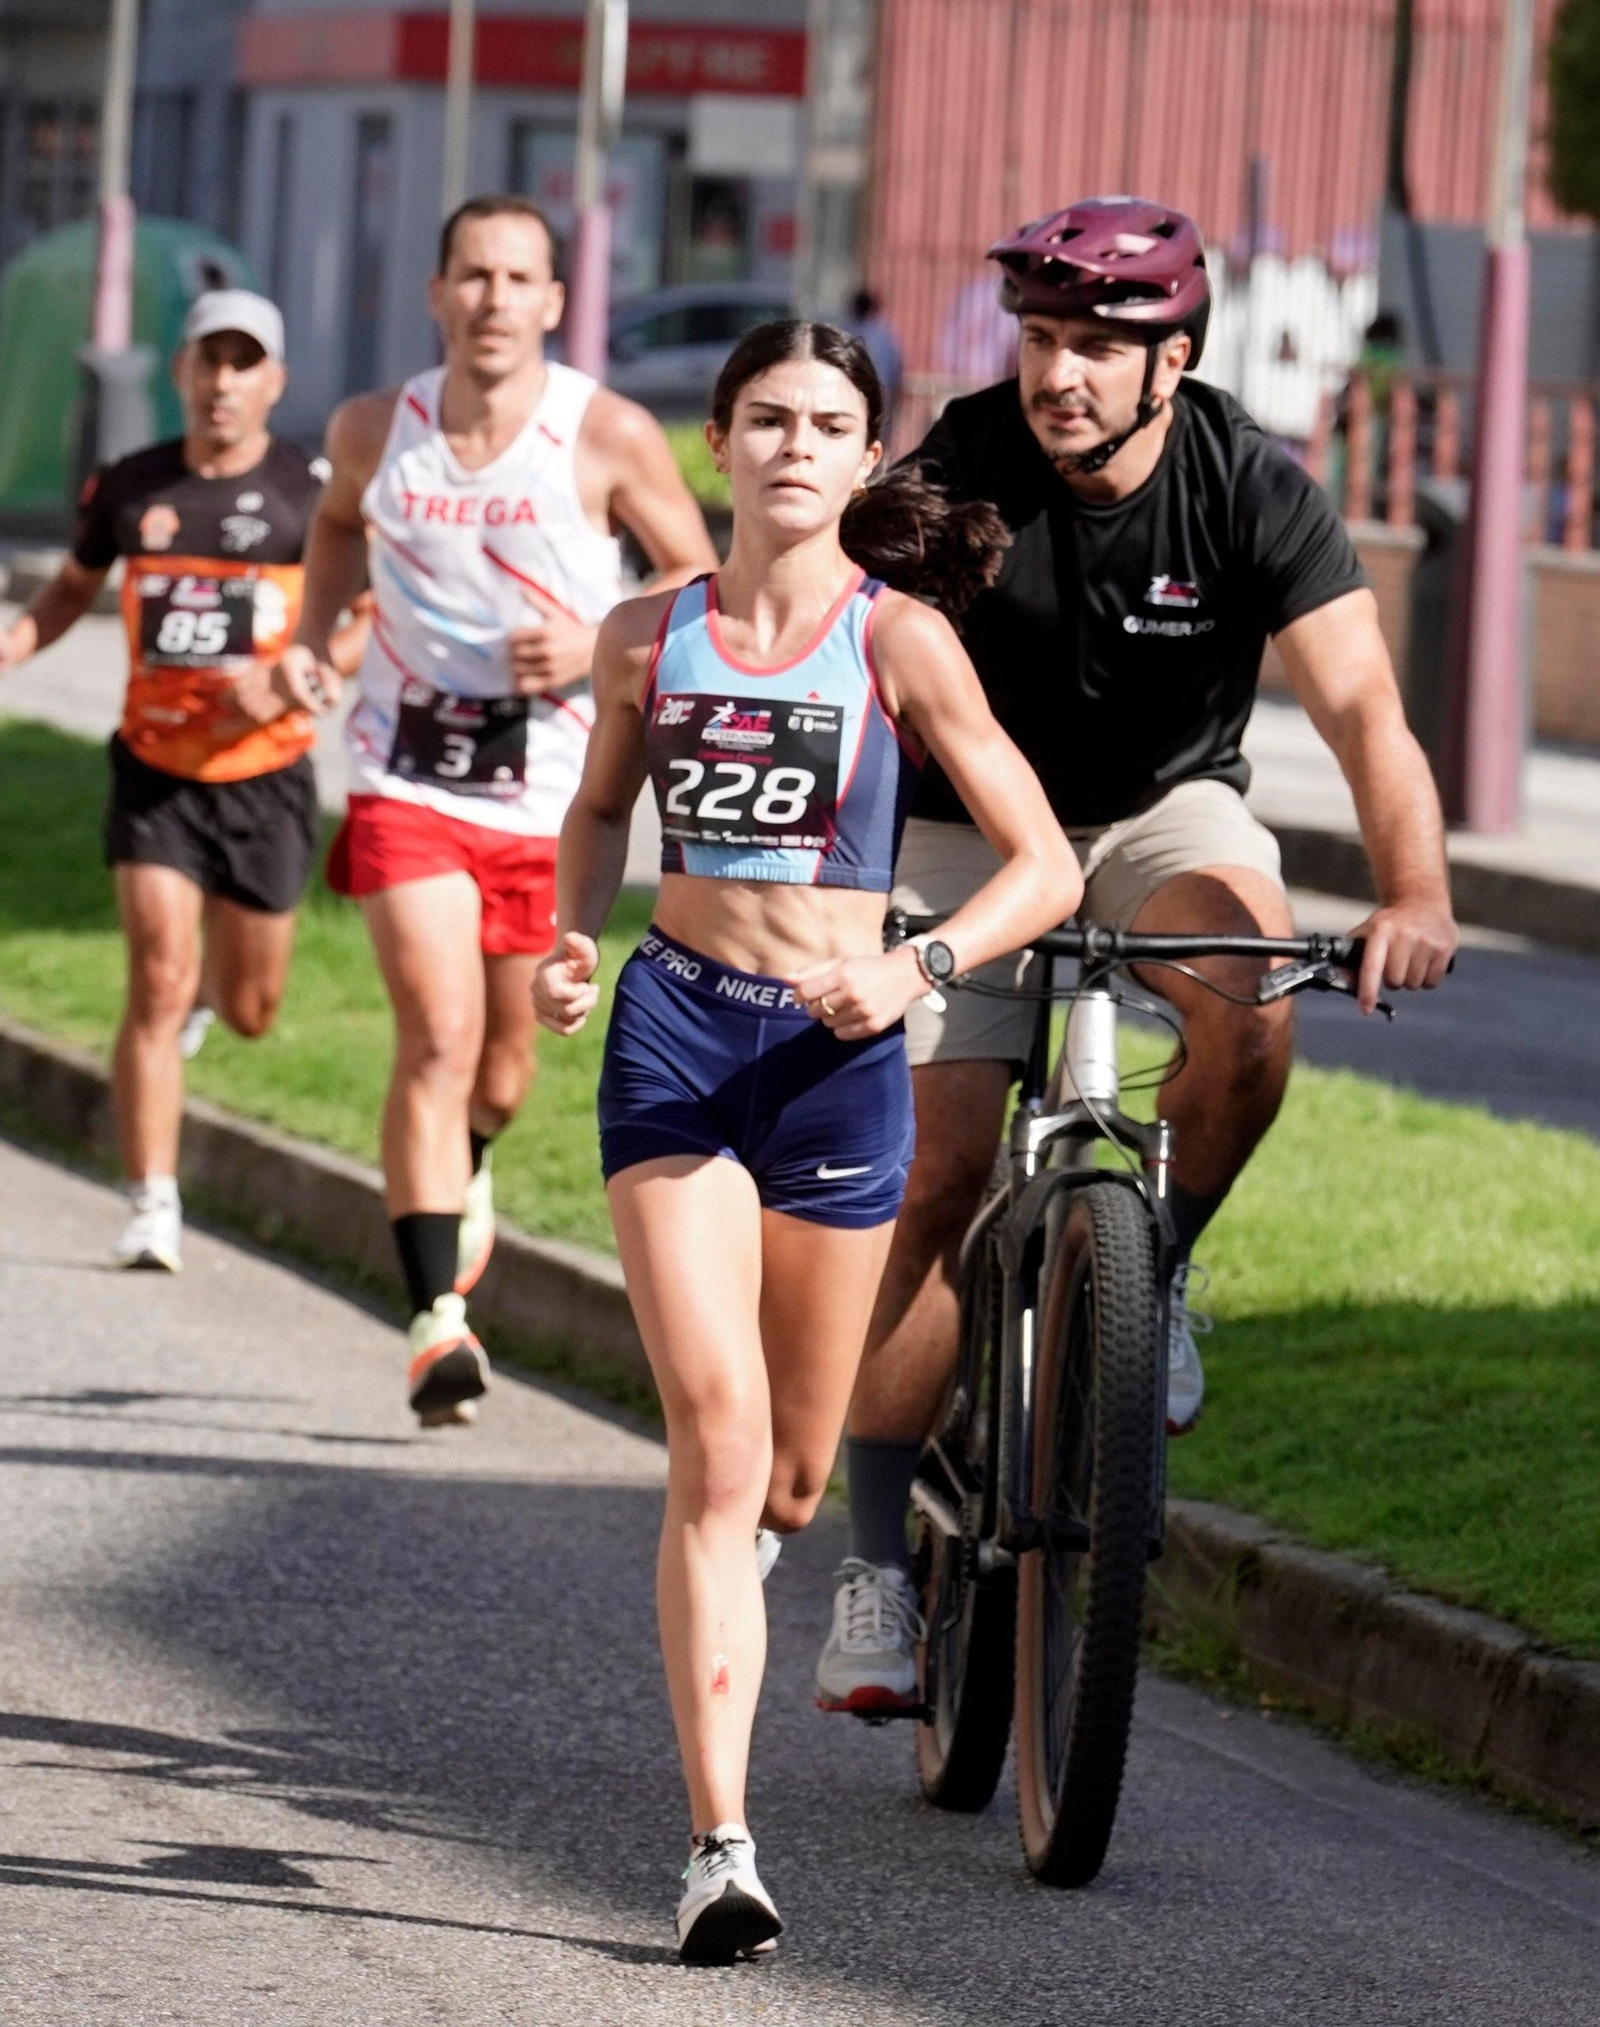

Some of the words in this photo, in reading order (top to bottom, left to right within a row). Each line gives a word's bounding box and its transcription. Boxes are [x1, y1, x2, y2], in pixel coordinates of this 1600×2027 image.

[401, 492, 536, 526] TREGA
[157, 611, 231, 655] 85
[434, 733, 476, 778] 3
[666, 759, 817, 825] 228
[655, 949, 702, 982] PRO
[716, 976, 778, 1007] NIKE
